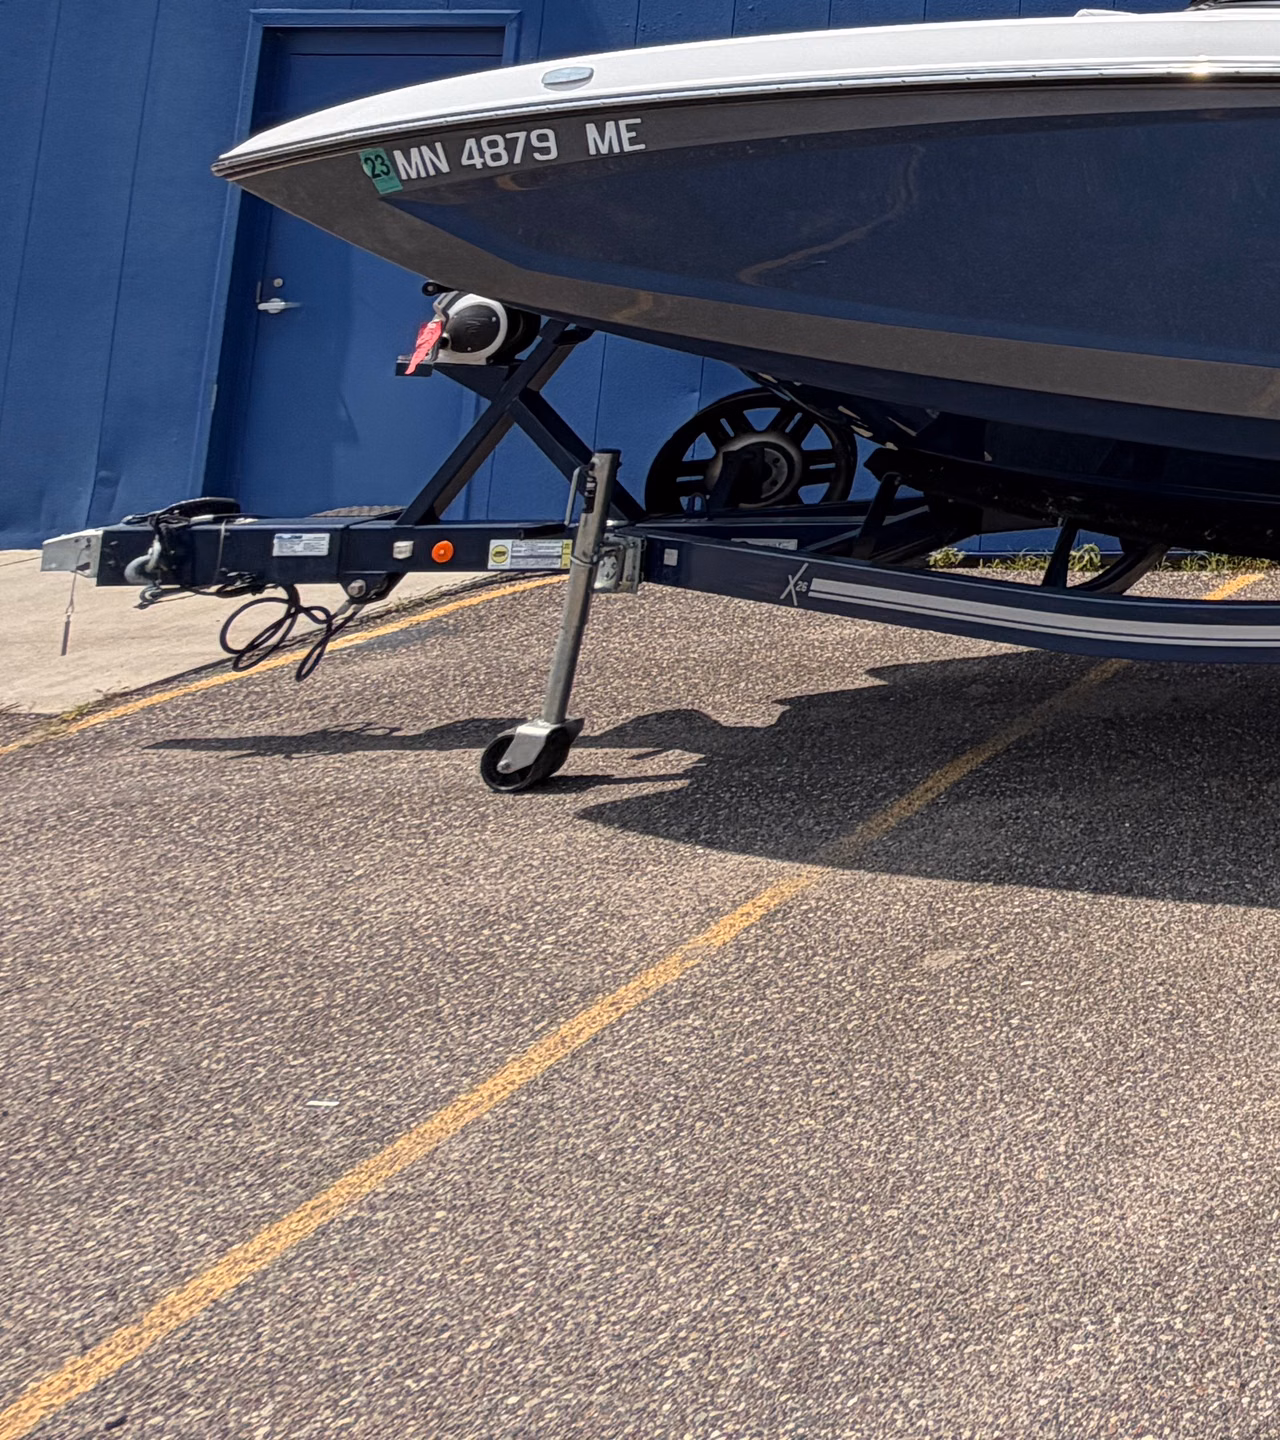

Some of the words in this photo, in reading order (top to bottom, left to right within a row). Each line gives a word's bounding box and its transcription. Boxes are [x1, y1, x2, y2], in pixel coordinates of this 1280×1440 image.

[363, 155, 392, 179] 23
[393, 142, 450, 180] MN
[461, 128, 558, 170] 4879
[585, 118, 646, 156] ME
